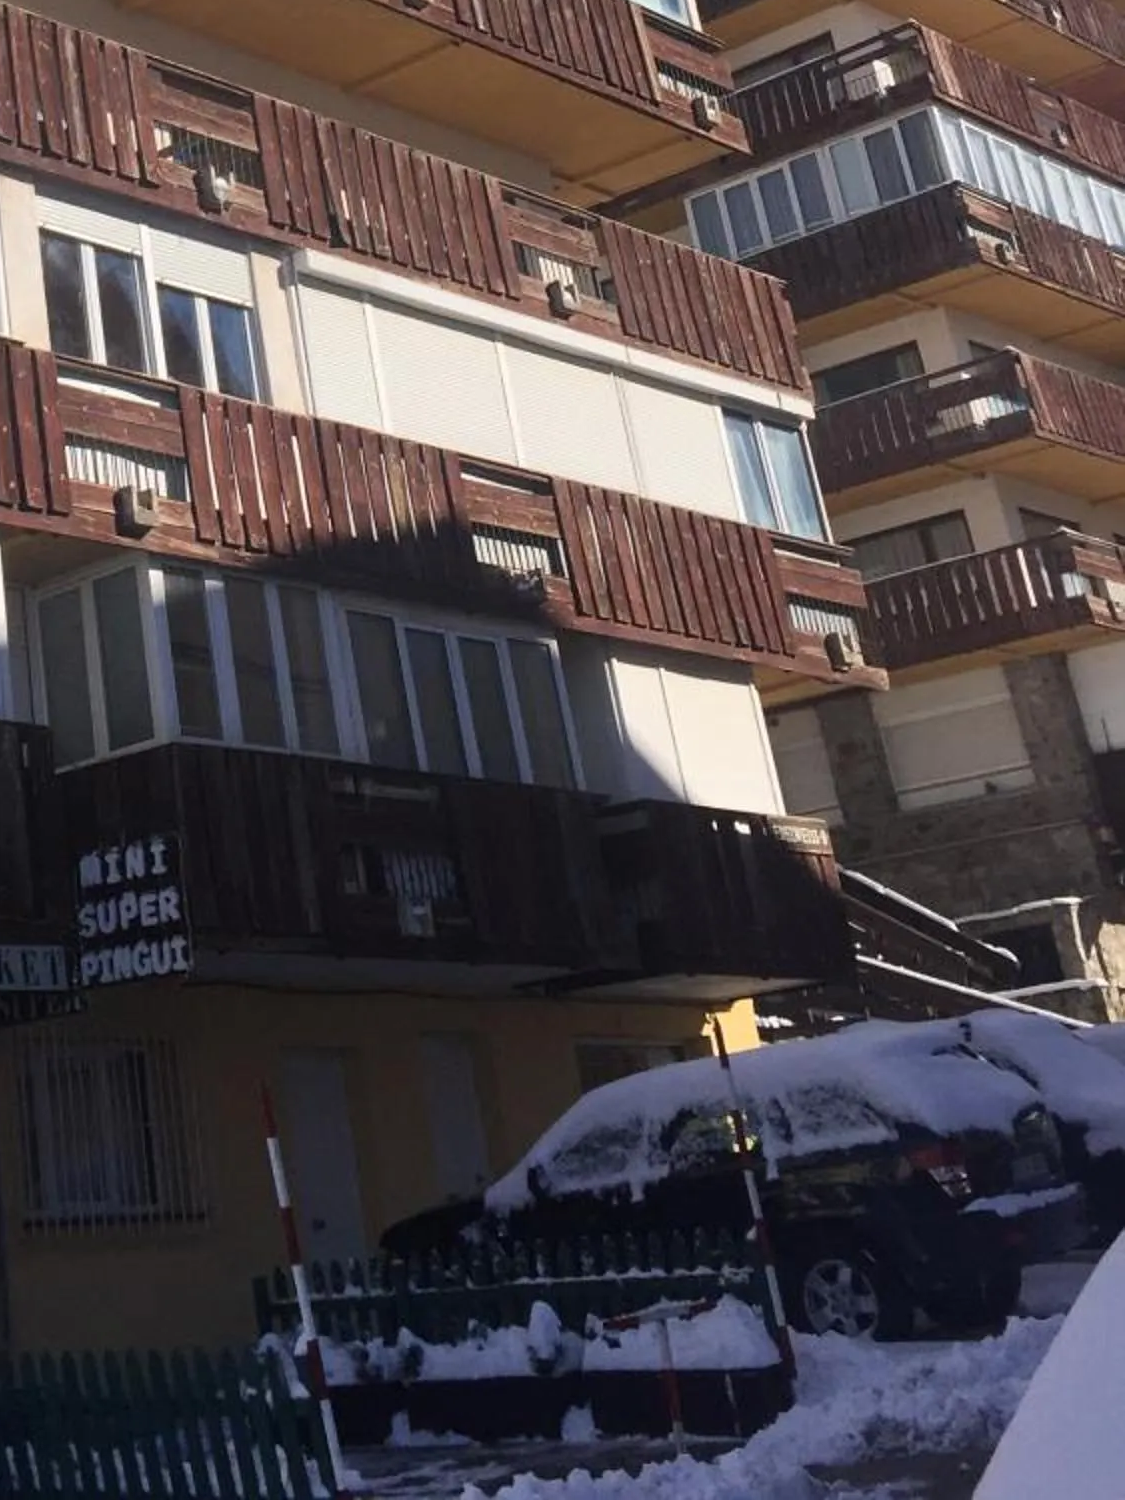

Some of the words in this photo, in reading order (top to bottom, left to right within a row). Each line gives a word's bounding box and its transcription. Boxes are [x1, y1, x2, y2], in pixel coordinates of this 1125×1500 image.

[79, 835, 168, 889] MINI
[78, 885, 182, 939] SUPER
[80, 933, 190, 987] PINGUI
